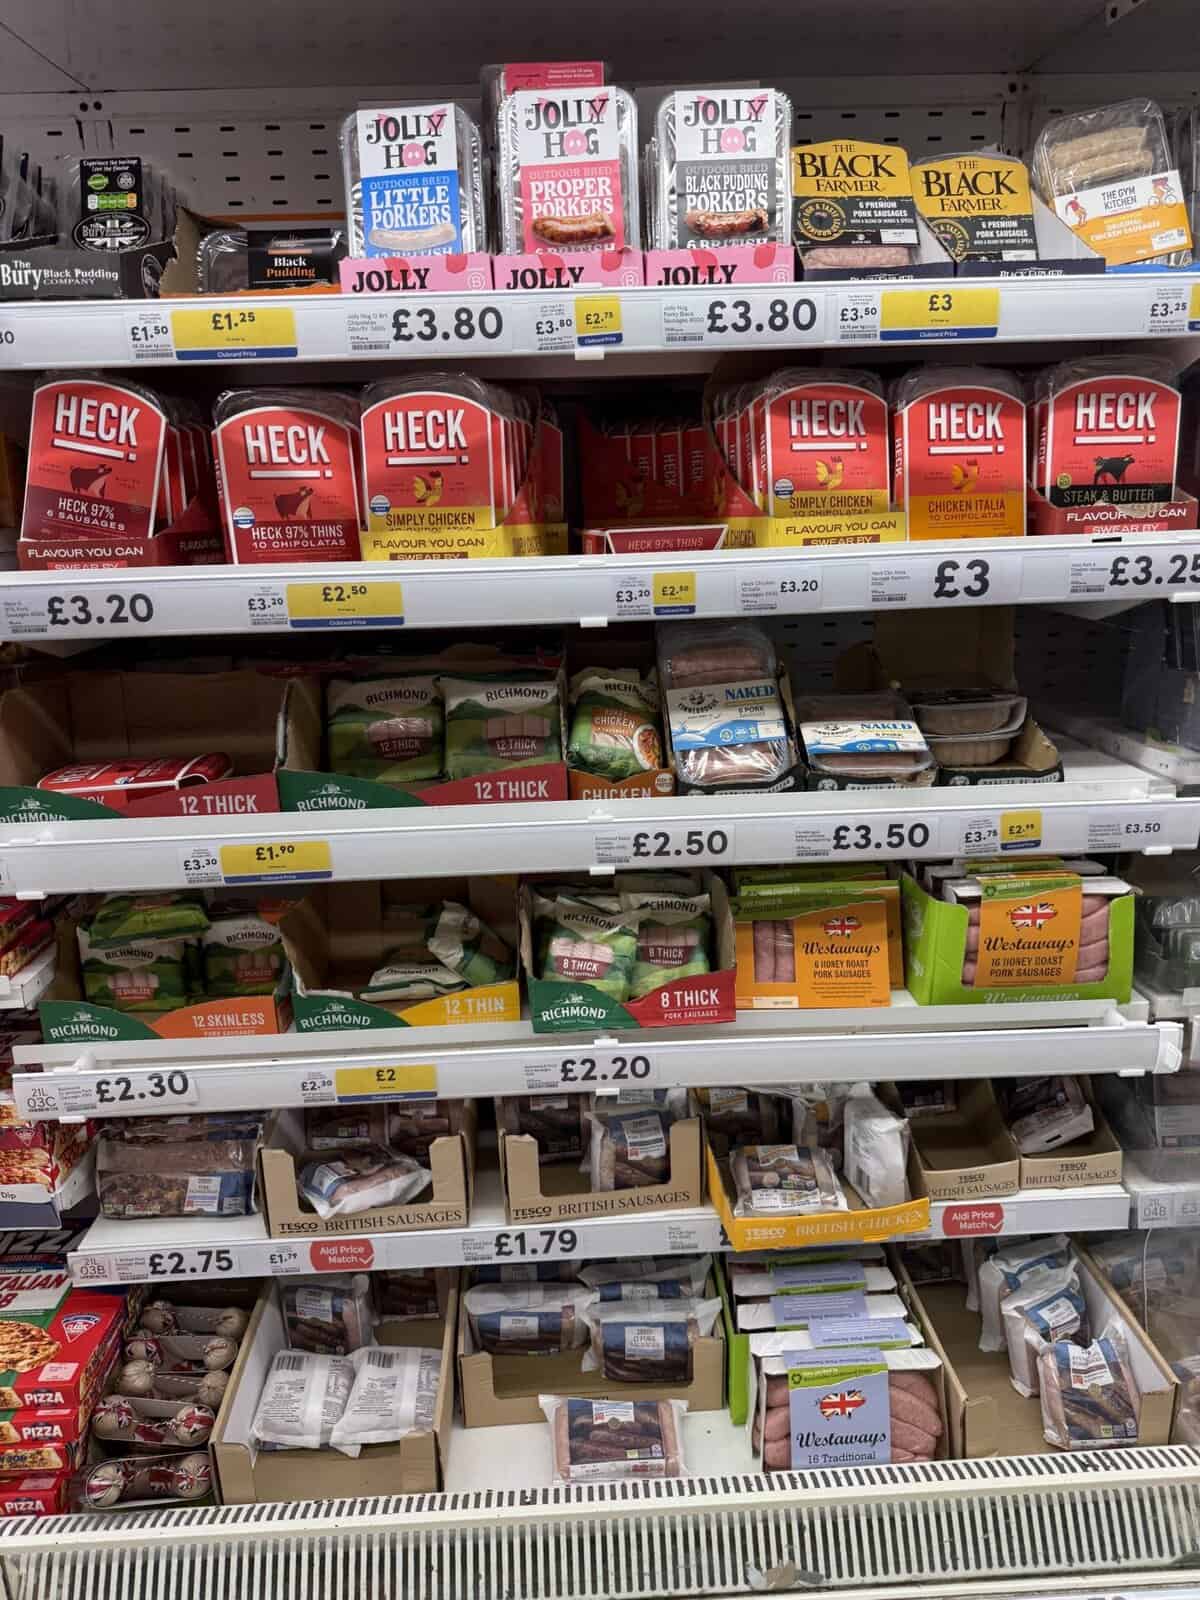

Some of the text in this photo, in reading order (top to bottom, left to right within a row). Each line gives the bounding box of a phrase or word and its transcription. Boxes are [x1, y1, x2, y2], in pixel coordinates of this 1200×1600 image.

[526, 99, 610, 130] JOLLY
[684, 99, 769, 127] JOLLY
[366, 113, 448, 144] JOLLY
[833, 144, 857, 153] THE
[798, 153, 897, 178] BLACK
[956, 160, 979, 170] THE
[529, 175, 612, 201] PROPER
[686, 173, 769, 193] BLACK PUDDING
[816, 180, 881, 194] FARMER
[922, 170, 1018, 197] BLACK
[369, 185, 450, 210] LITTLE
[1101, 186, 1136, 201] THE GYM
[531, 197, 614, 220] PORKERS
[686, 191, 769, 214] PORKERS
[940, 197, 1001, 213] FARMER
[1104, 196, 1137, 210] KITCHEN
[371, 203, 451, 230] PORKERS
[976, 229, 1029, 238] PORK SAUSAGES
[12, 260, 31, 269] The
[273, 256, 307, 267] Black
[0, 263, 43, 291] Bury
[43, 268, 119, 281] Black Pudding
[266, 266, 316, 279] Pudding
[352, 268, 430, 293] JOLLY
[507, 267, 584, 289] JOLLY
[657, 265, 738, 286] JOLLY
[43, 278, 97, 286] COMPANY
[928, 294, 953, 312] £3
[1150, 301, 1188, 318] £3.25
[211, 311, 256, 331] £1.25
[707, 298, 817, 334] £3.80
[840, 306, 878, 322] £3.50
[391, 306, 504, 342] £3.80
[535, 318, 573, 335] £3.80
[131, 325, 169, 342] £1.50
[789, 399, 867, 438] HECK
[1075, 390, 1158, 431] HECK
[54, 392, 142, 447] HECK
[928, 401, 1005, 441] HECK
[383, 408, 469, 451] HECK
[243, 424, 332, 465] HECK
[790, 495, 873, 510] SIMPLY CHICKEN
[1063, 488, 1154, 504] STEAK & BUTTER
[58, 497, 115, 520] HECK 97%
[928, 498, 1006, 513] CHICKEN ITALIA
[58, 512, 126, 531] SAUSAGES
[386, 511, 476, 527] SIMPLY CHICKEN
[1066, 509, 1128, 522] FLAVOUR
[1159, 507, 1187, 518] CAN
[251, 524, 344, 540] HECK 97% THINS
[785, 520, 897, 535] FLAVOUR YOU CAN
[252, 538, 346, 550] 10 CHIPOLATAS
[373, 537, 485, 549] FLAVOUR YOU CAN
[628, 537, 704, 550] HECK THINS
[27, 546, 144, 559] FLAVOUR YOU CAN
[780, 580, 818, 593] £3.20
[933, 559, 991, 599] £3
[321, 585, 368, 603] £2.50
[615, 589, 650, 603] £3.20
[47, 592, 155, 626] £3.20
[366, 690, 430, 705] RICHMOND
[485, 688, 549, 702] RICHMOND
[724, 683, 778, 700] NAKED
[745, 706, 765, 714] PORK
[594, 716, 636, 729] CHICKEN
[860, 721, 914, 731] NAKED
[393, 739, 421, 751] THICK
[509, 739, 537, 750] THICK
[474, 780, 549, 799] 12 THICK
[582, 788, 652, 801] CHICKEN
[179, 794, 259, 814] 12 THICK
[297, 797, 367, 813] RICHMOND
[832, 822, 930, 850] £3.50
[1125, 822, 1161, 834] £3.50
[632, 830, 729, 857] £2.50
[964, 829, 998, 844] £3.75
[255, 845, 296, 861] £1.90
[226, 932, 275, 944] RICHMOND
[983, 936, 1075, 952] Westaways
[105, 949, 154, 960] RICHMOND
[658, 948, 684, 959] THICK
[801, 942, 881, 957] Westaways
[563, 958, 599, 972] 8 THICK
[990, 967, 1062, 977] PORK SAUSAGES
[813, 970, 833, 978] PORK
[443, 996, 505, 1014] 12 THIN
[660, 988, 720, 1008] 8 THICK
[192, 1012, 265, 1028] 12 SKINLESS
[301, 1014, 371, 1029] RICHMOND
[541, 1006, 607, 1021] RICHMOND
[664, 1010, 718, 1020] PORK SAUSAGES
[50, 1024, 119, 1039] RICHMOND
[375, 1068, 397, 1082] £2
[560, 1056, 651, 1082] £2.20
[95, 1070, 189, 1103] £2.30
[1025, 1168, 1119, 1185] BRITISH SAUSAGES
[965, 1180, 1017, 1195] SAUSAGES
[512, 1191, 691, 1216] TESCO BRITISH SAUSAGES
[278, 1210, 463, 1232] TESCO BRITISH SAUSAGES
[952, 1210, 995, 1221] Aldi Price
[744, 1221, 851, 1237] TESCO BRITISH
[958, 1220, 988, 1230] Match
[319, 1245, 365, 1256] Aldi Price
[494, 1229, 578, 1257] £1.79
[149, 1249, 234, 1275] £2.75
[328, 1254, 358, 1264] Match
[23, 1391, 65, 1405] PIZZA
[21, 1425, 63, 1440] PIZZA
[796, 1432, 887, 1449] Westaways
[821, 1451, 877, 1464] Traditional
[4, 1500, 46, 1513] PIZZA
